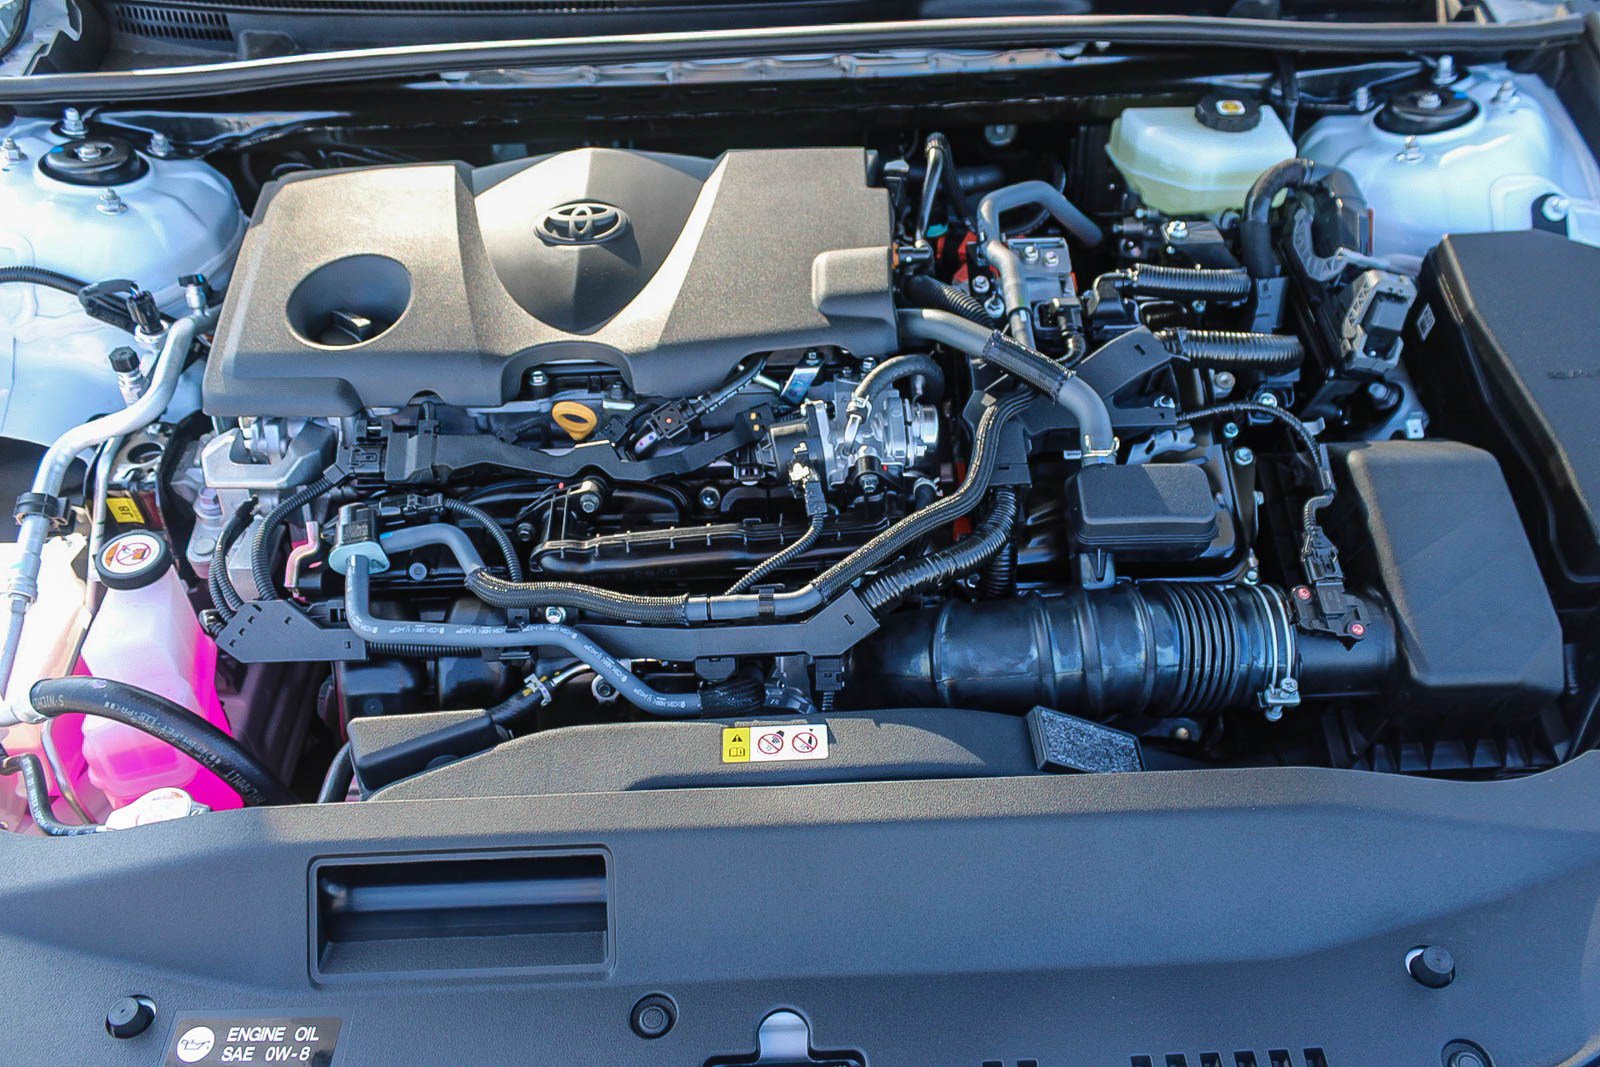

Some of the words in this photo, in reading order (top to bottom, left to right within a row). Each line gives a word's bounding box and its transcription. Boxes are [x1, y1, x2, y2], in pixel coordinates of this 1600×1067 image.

[226, 1026, 286, 1041] ENGINE
[294, 1026, 319, 1041] OIL
[221, 1047, 255, 1061] SAE
[265, 1046, 310, 1061] 0W-8
